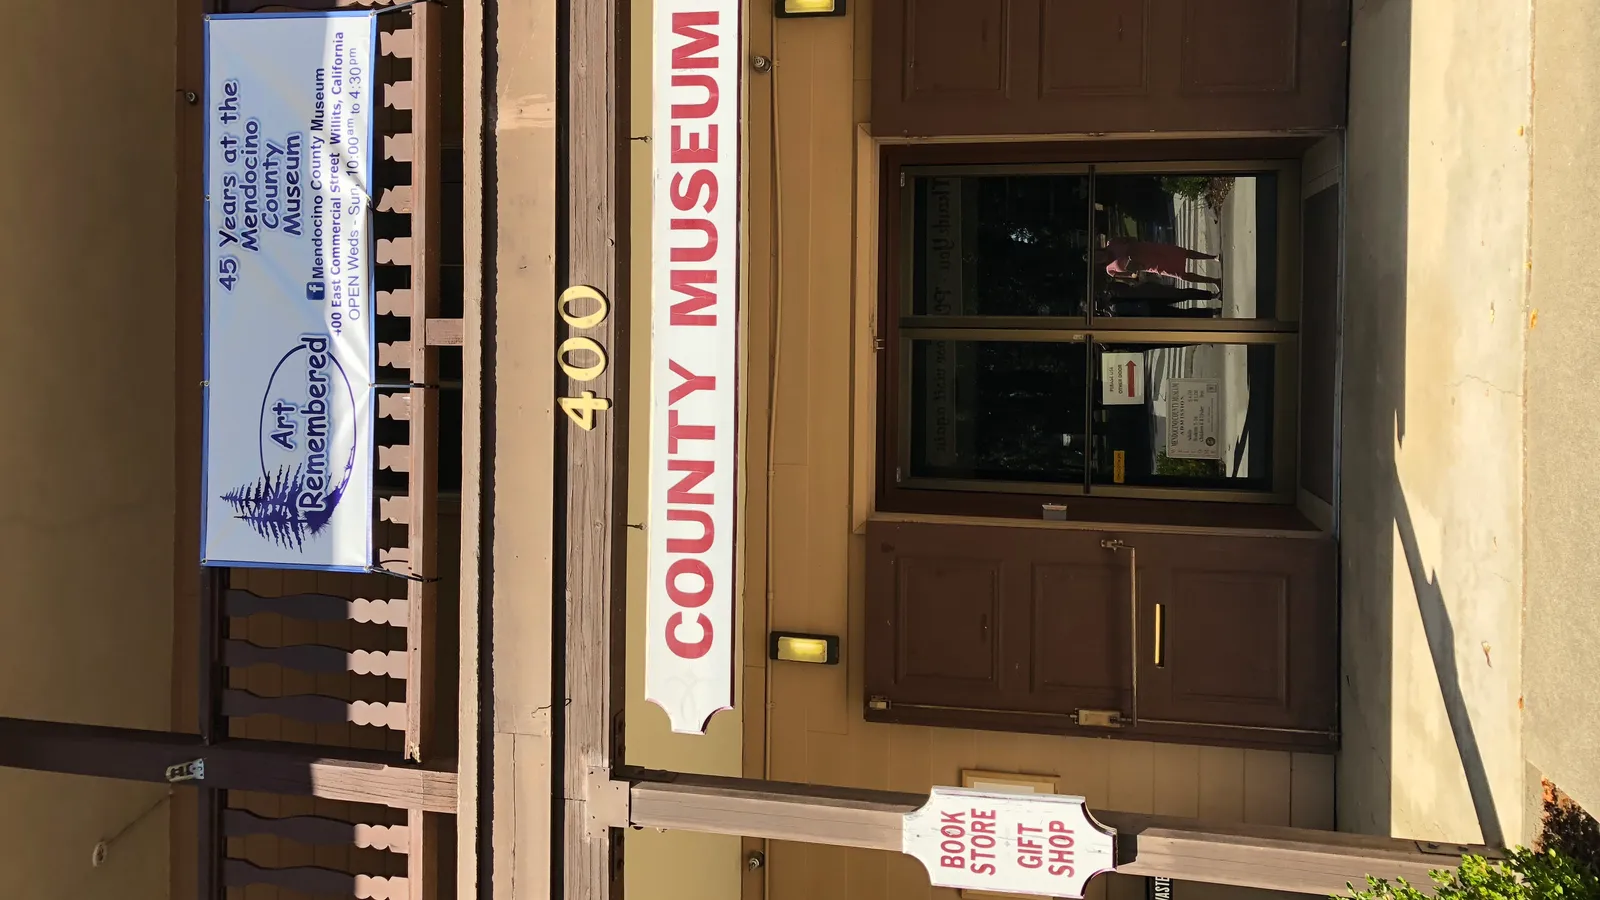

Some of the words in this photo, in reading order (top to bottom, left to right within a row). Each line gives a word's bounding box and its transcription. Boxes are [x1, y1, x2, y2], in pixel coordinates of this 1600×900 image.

[330, 32, 344, 95] California
[348, 48, 361, 99] 4:30pm
[219, 82, 237, 124] the
[311, 68, 325, 131] Museum
[330, 100, 343, 144] Willits,
[350, 104, 360, 114] to
[220, 136, 237, 163] at
[310, 137, 324, 190] County
[329, 152, 340, 192] Street
[346, 118, 359, 176] 10:00am
[670, 11, 719, 326] MUSEUM
[219, 176, 238, 247] Years
[239, 121, 258, 252] Mendocino
[262, 142, 283, 229] County
[283, 134, 302, 236] Museum
[348, 184, 362, 215] Sun,
[311, 196, 324, 279] Mendocino
[330, 198, 342, 275] Commercial
[348, 230, 360, 270] Weds
[219, 258, 237, 291] 45
[330, 280, 342, 308] East
[348, 276, 360, 320] OPEN
[557, 285, 610, 431] 400
[270, 402, 294, 449] Art
[299, 338, 327, 509] Remembered
[665, 358, 716, 660] COUNTY
[940, 810, 966, 868] BOOK
[970, 808, 996, 876] STORE
[1017, 823, 1042, 868] GIFT
[1048, 820, 1074, 878] SHOP
